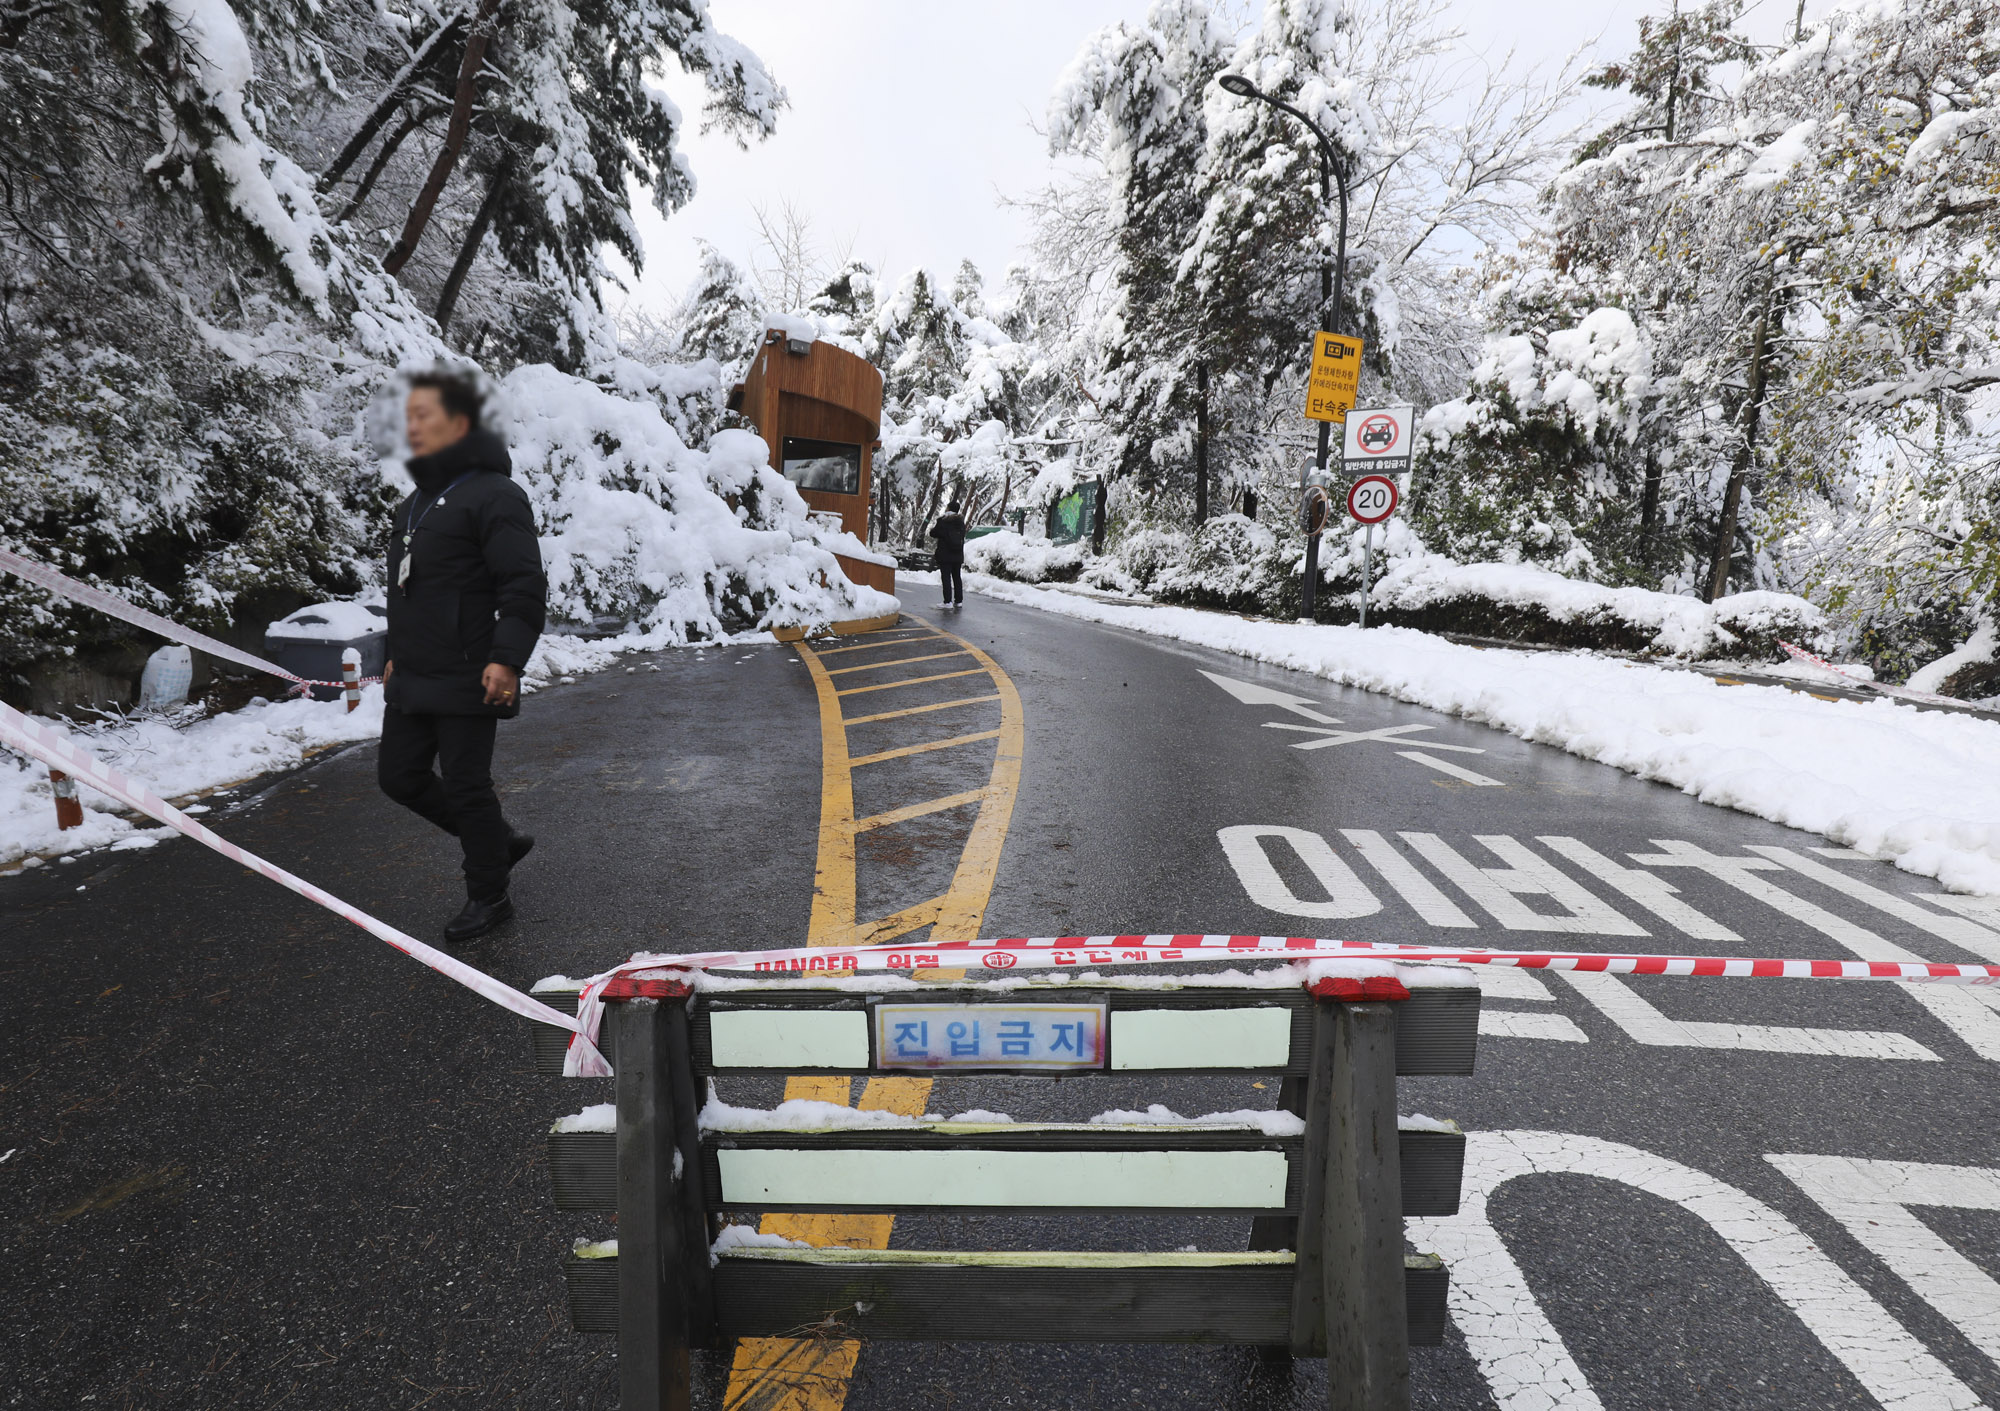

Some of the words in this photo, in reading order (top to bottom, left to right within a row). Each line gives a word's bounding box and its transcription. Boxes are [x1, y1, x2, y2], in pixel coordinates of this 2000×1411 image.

[1317, 365, 1354, 380] 운행제한차량
[1312, 378, 1355, 393] 카메라단속지역
[1312, 398, 1348, 417] 단속중
[1344, 461, 1374, 471] 일반차량
[1376, 459, 1407, 469] 출입금지
[1358, 489, 1386, 508] 20
[894, 1020, 1085, 1058] 진입금지
